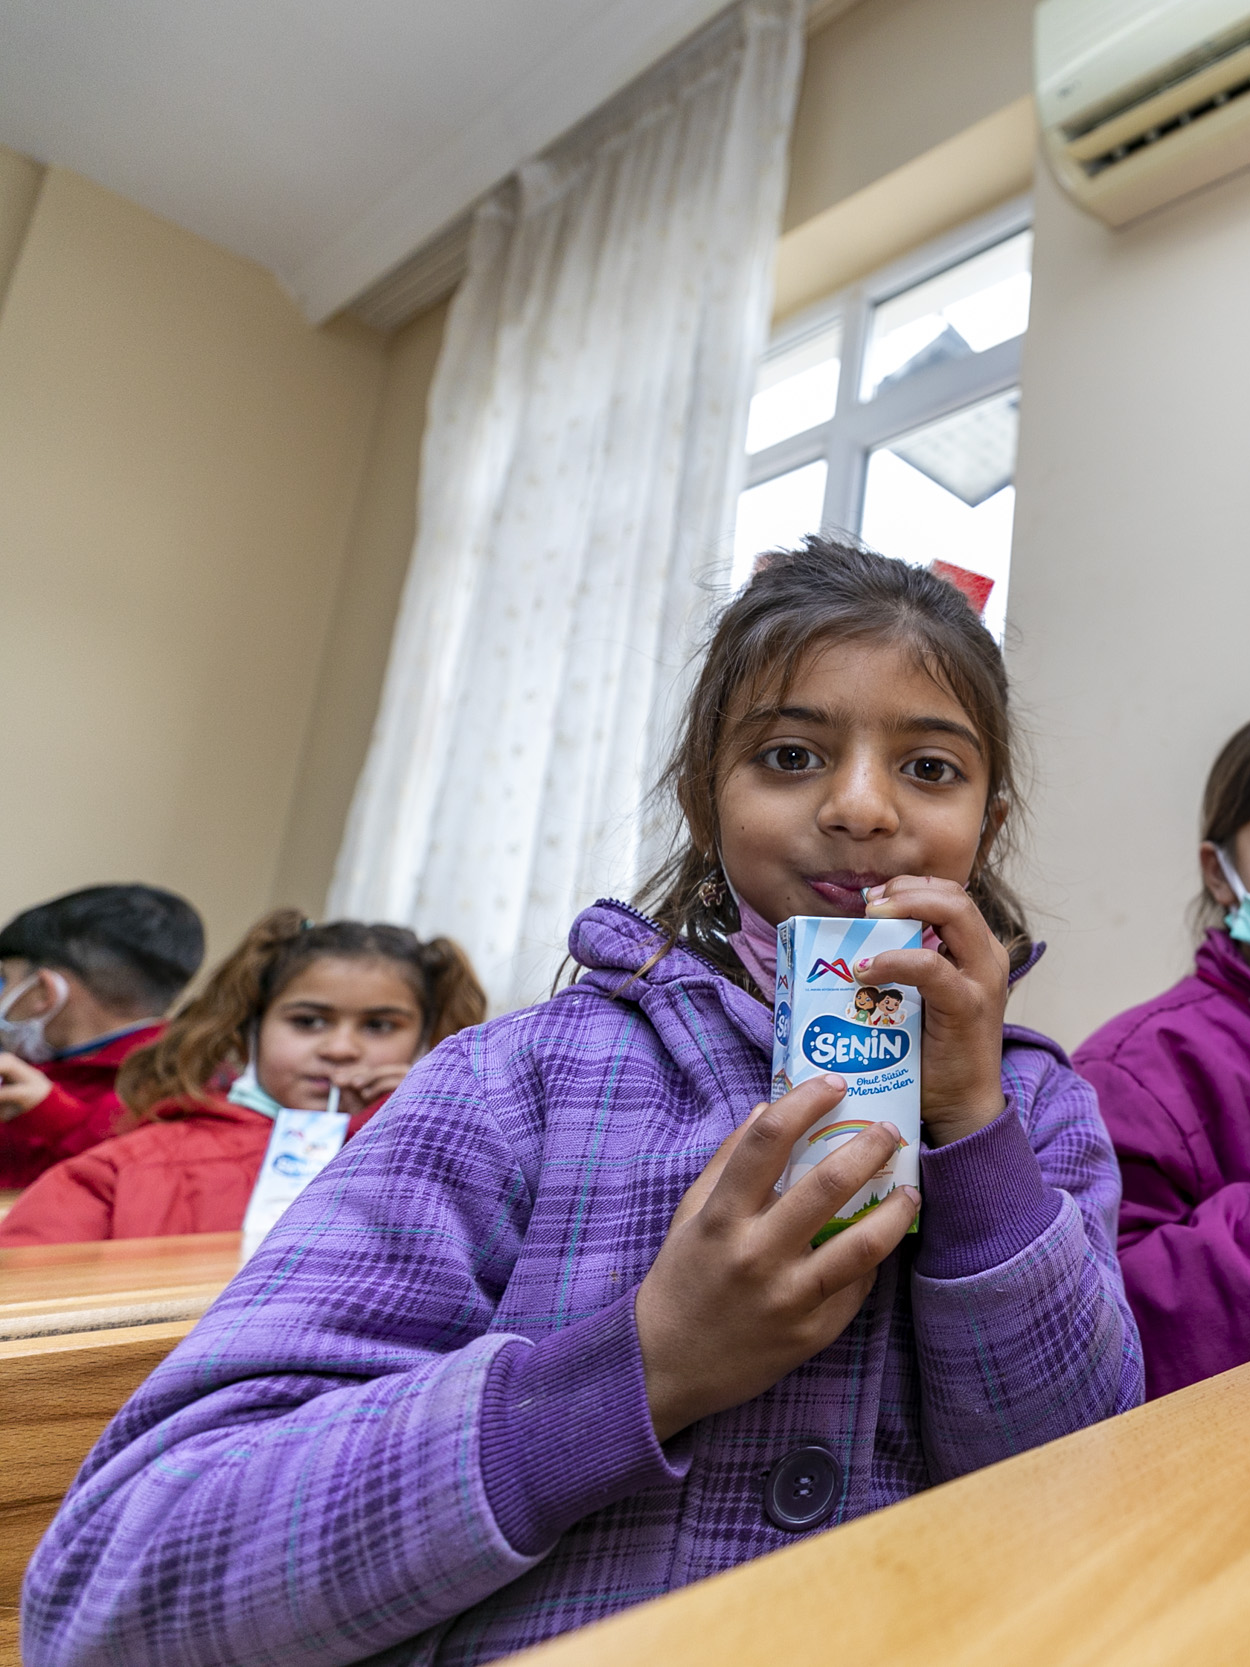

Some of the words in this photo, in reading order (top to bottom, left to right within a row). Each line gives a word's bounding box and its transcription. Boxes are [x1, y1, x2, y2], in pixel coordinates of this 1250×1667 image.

[856, 1075, 880, 1086] Okul
[881, 1068, 909, 1082] Sütün
[847, 1078, 914, 1097] Mersin'den
